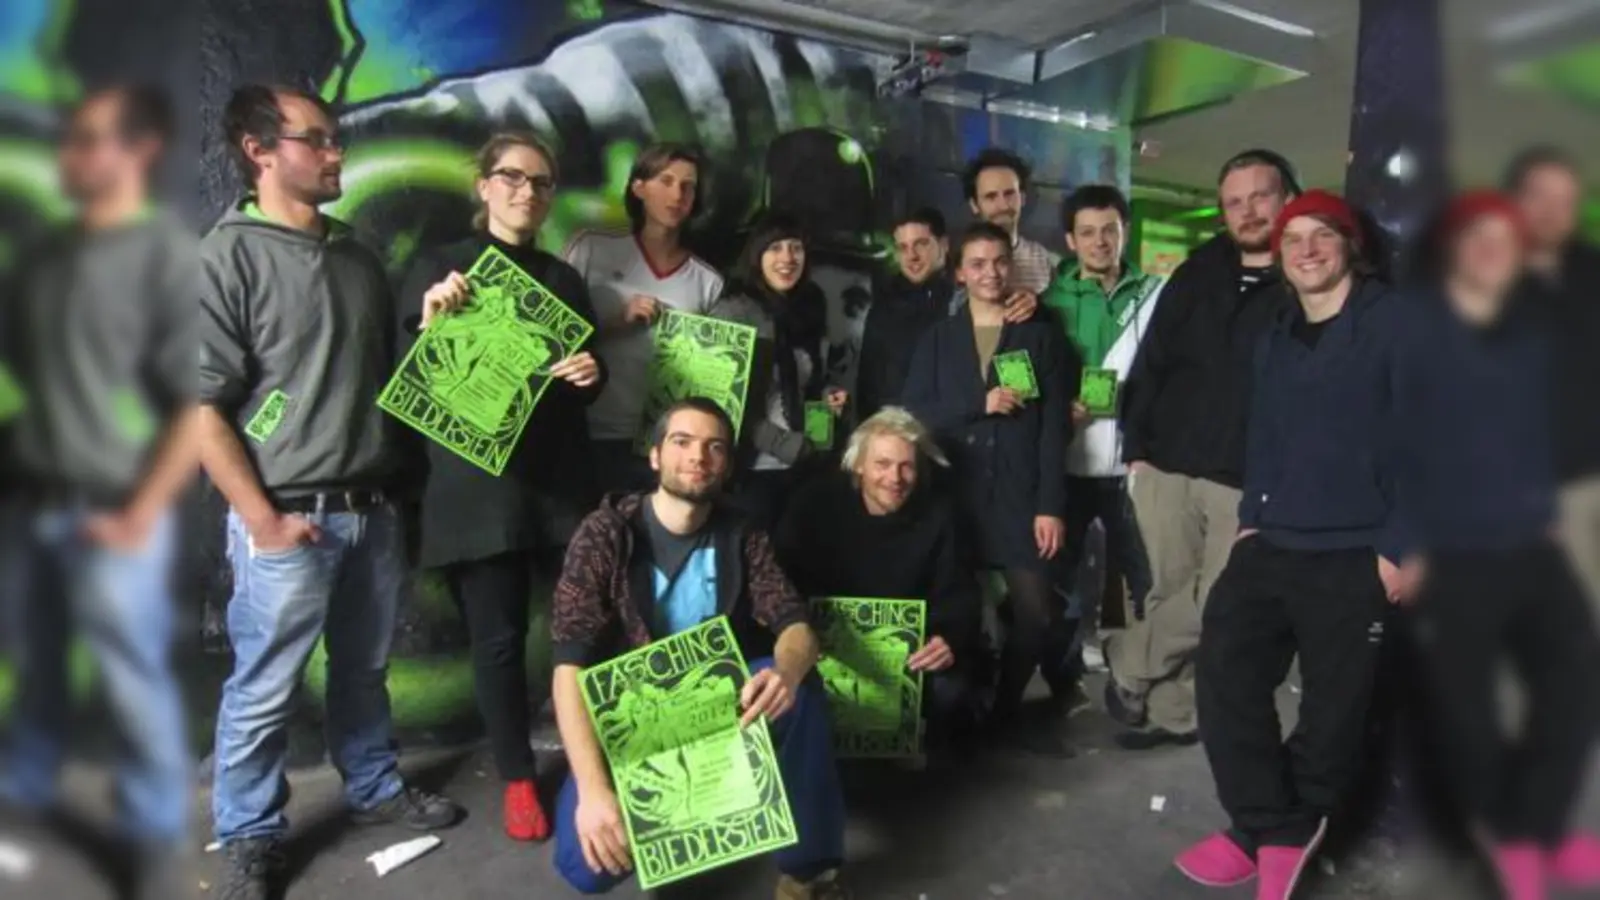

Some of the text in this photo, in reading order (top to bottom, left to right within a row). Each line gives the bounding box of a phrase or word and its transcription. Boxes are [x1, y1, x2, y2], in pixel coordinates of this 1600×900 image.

[479, 254, 585, 345] FASCHING
[390, 380, 512, 469] BIEDERSTEIN
[592, 623, 732, 703] FASCHING
[641, 804, 791, 878] BIEDERSTEIN
